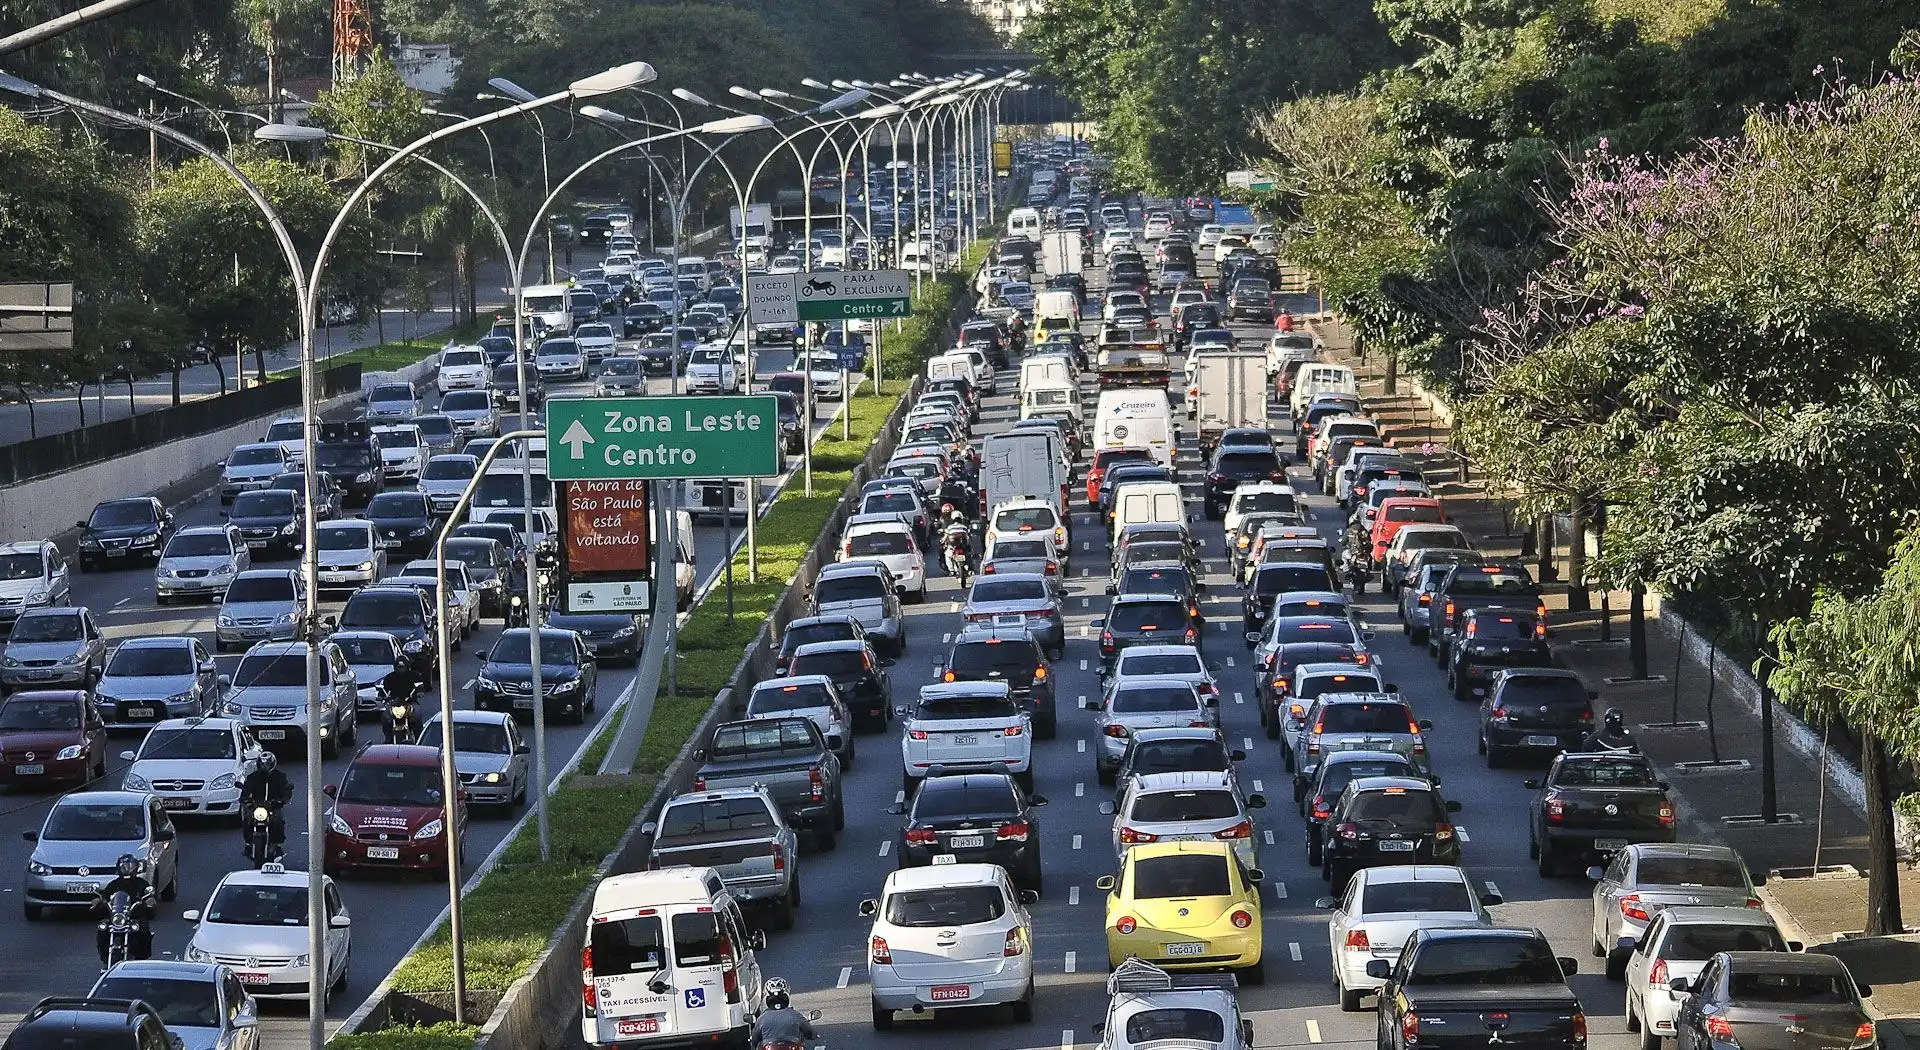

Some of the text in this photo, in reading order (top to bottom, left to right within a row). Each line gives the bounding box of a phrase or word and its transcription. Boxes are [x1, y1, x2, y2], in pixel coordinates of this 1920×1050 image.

[843, 274, 876, 284] FAIXA
[755, 282, 788, 290] EXCETO
[844, 285, 903, 296] EXCLUSIVA
[754, 294, 792, 304] DOMINGO
[843, 304, 884, 315] Centro
[841, 352, 854, 360] Km
[604, 409, 761, 433] Zona Leste
[604, 443, 697, 466] Centro
[569, 480, 643, 492] A hora de
[571, 495, 642, 511] São Paulo
[593, 514, 622, 528] está
[576, 531, 640, 546] voltando
[936, 855, 954, 864] TAXI
[265, 864, 281, 872] TAXI
[623, 996, 668, 1005] ACESSÍVEL
